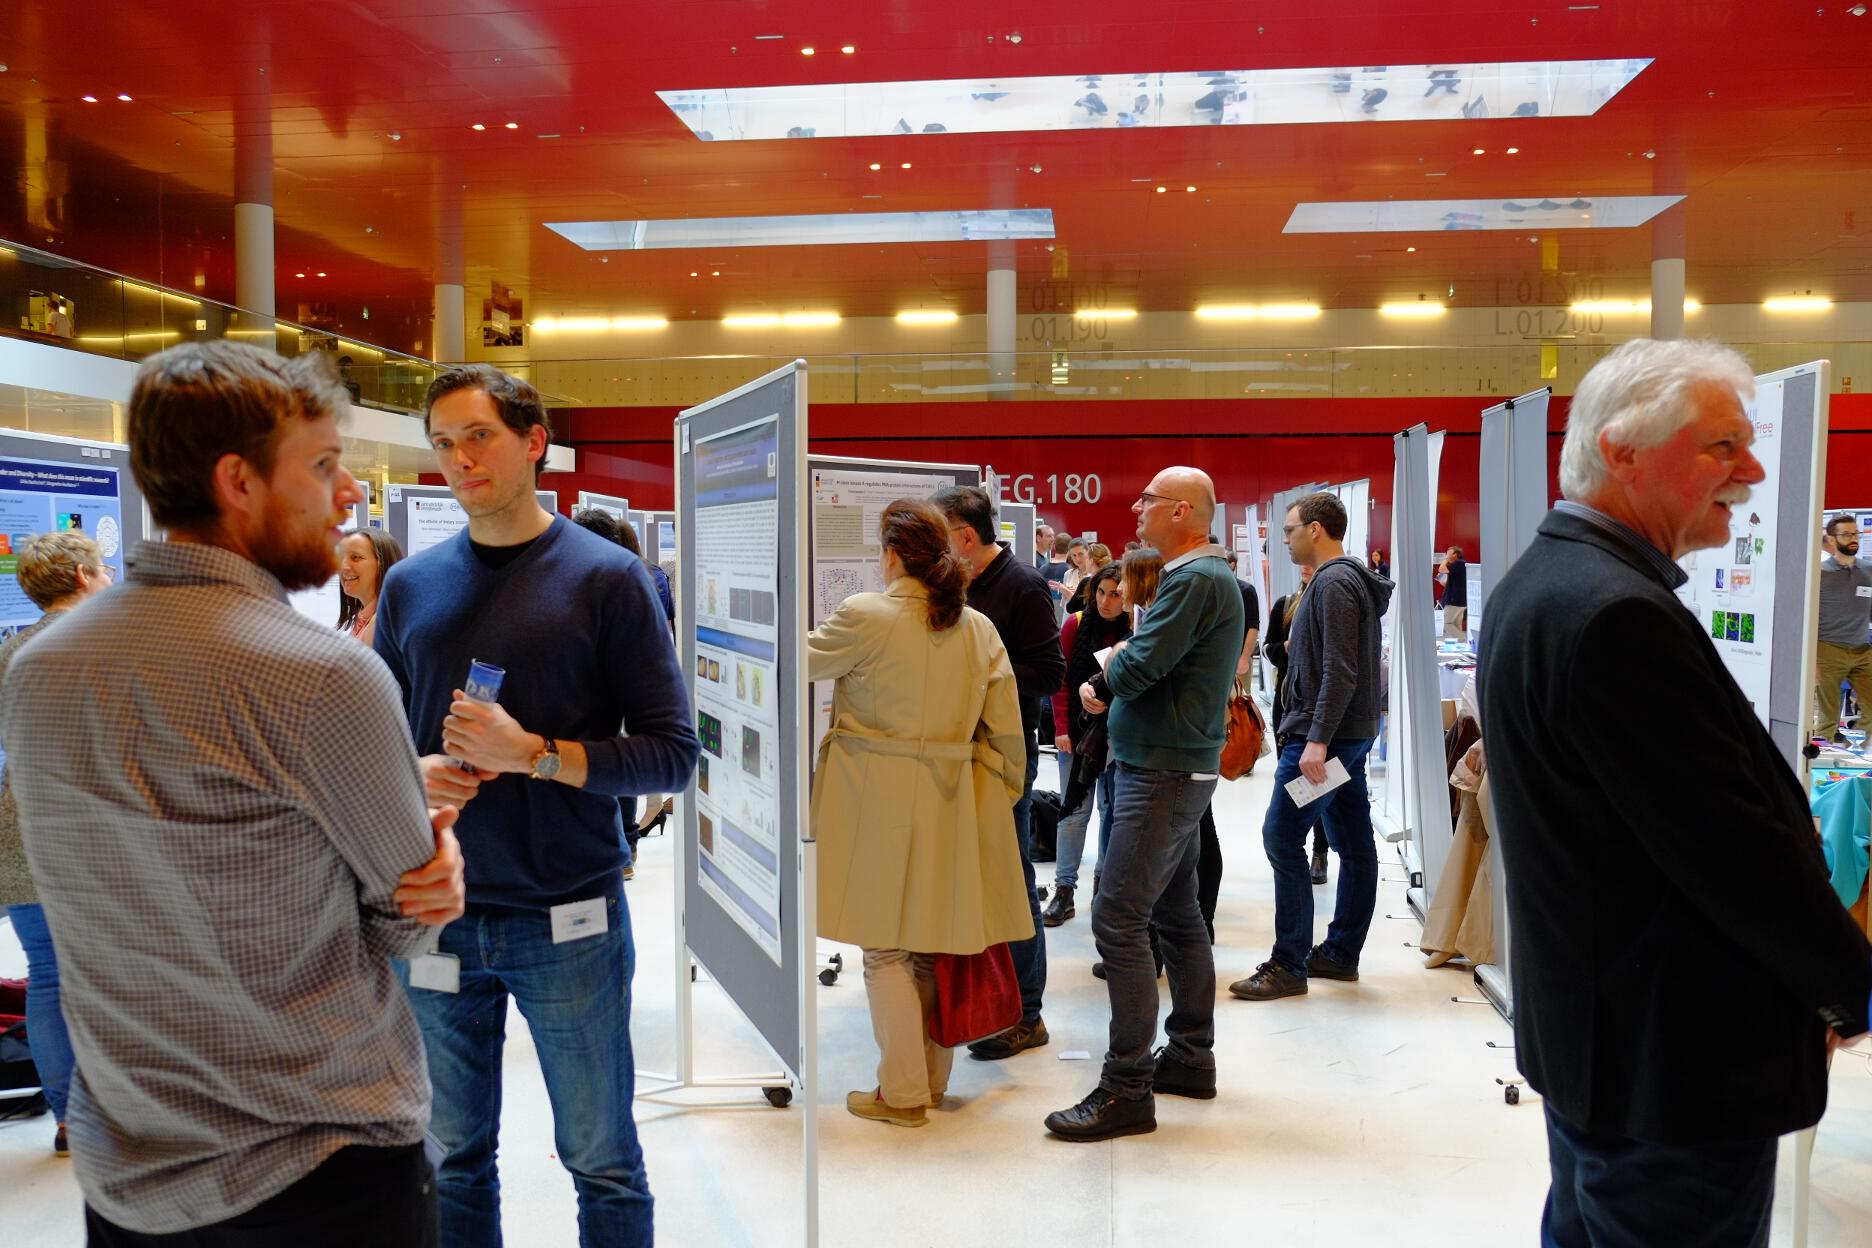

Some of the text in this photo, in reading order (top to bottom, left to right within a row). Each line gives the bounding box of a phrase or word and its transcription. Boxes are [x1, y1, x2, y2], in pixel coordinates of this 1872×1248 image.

[1016, 317, 1108, 341] .01.190
[1495, 310, 1604, 335] L.01.200
[996, 474, 1102, 504] EG.180
